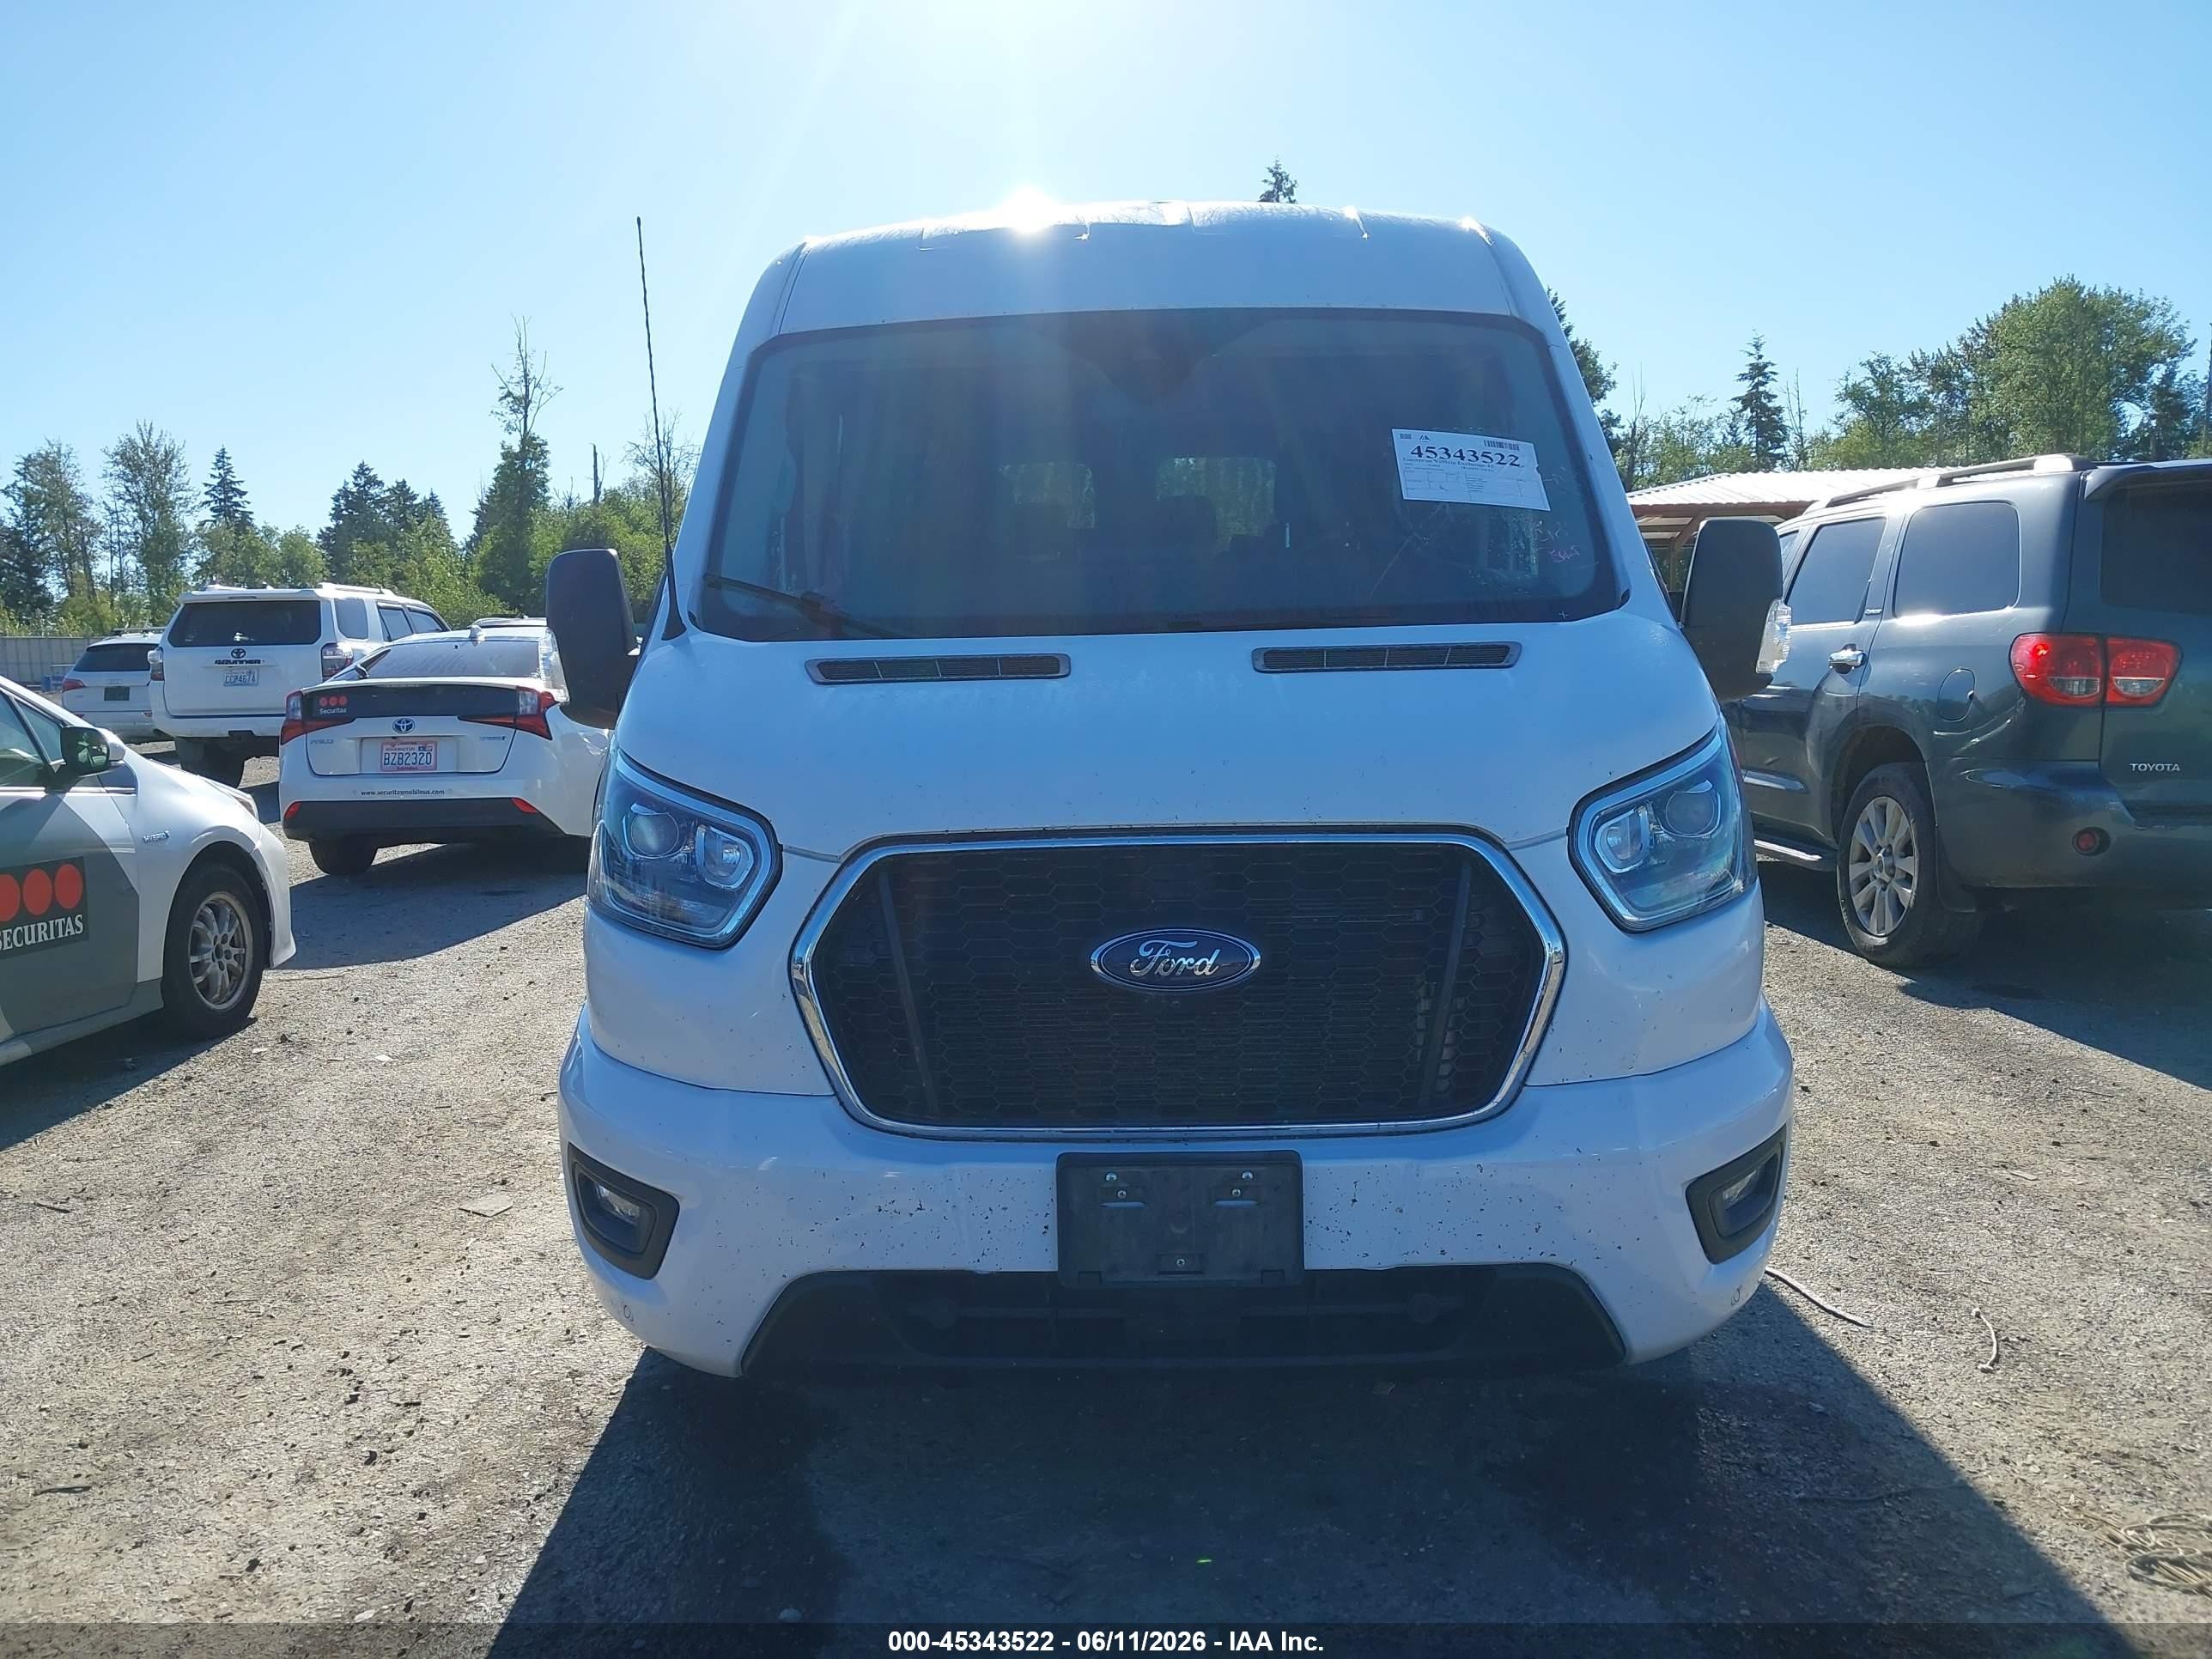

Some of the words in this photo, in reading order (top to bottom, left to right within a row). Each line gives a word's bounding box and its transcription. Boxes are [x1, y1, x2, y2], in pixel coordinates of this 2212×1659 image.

[1410, 445, 1521, 468] 45343522
[384, 752, 432, 766] BZB2320
[2129, 763, 2181, 772] TOYOTA
[1130, 939, 1221, 977] Ford
